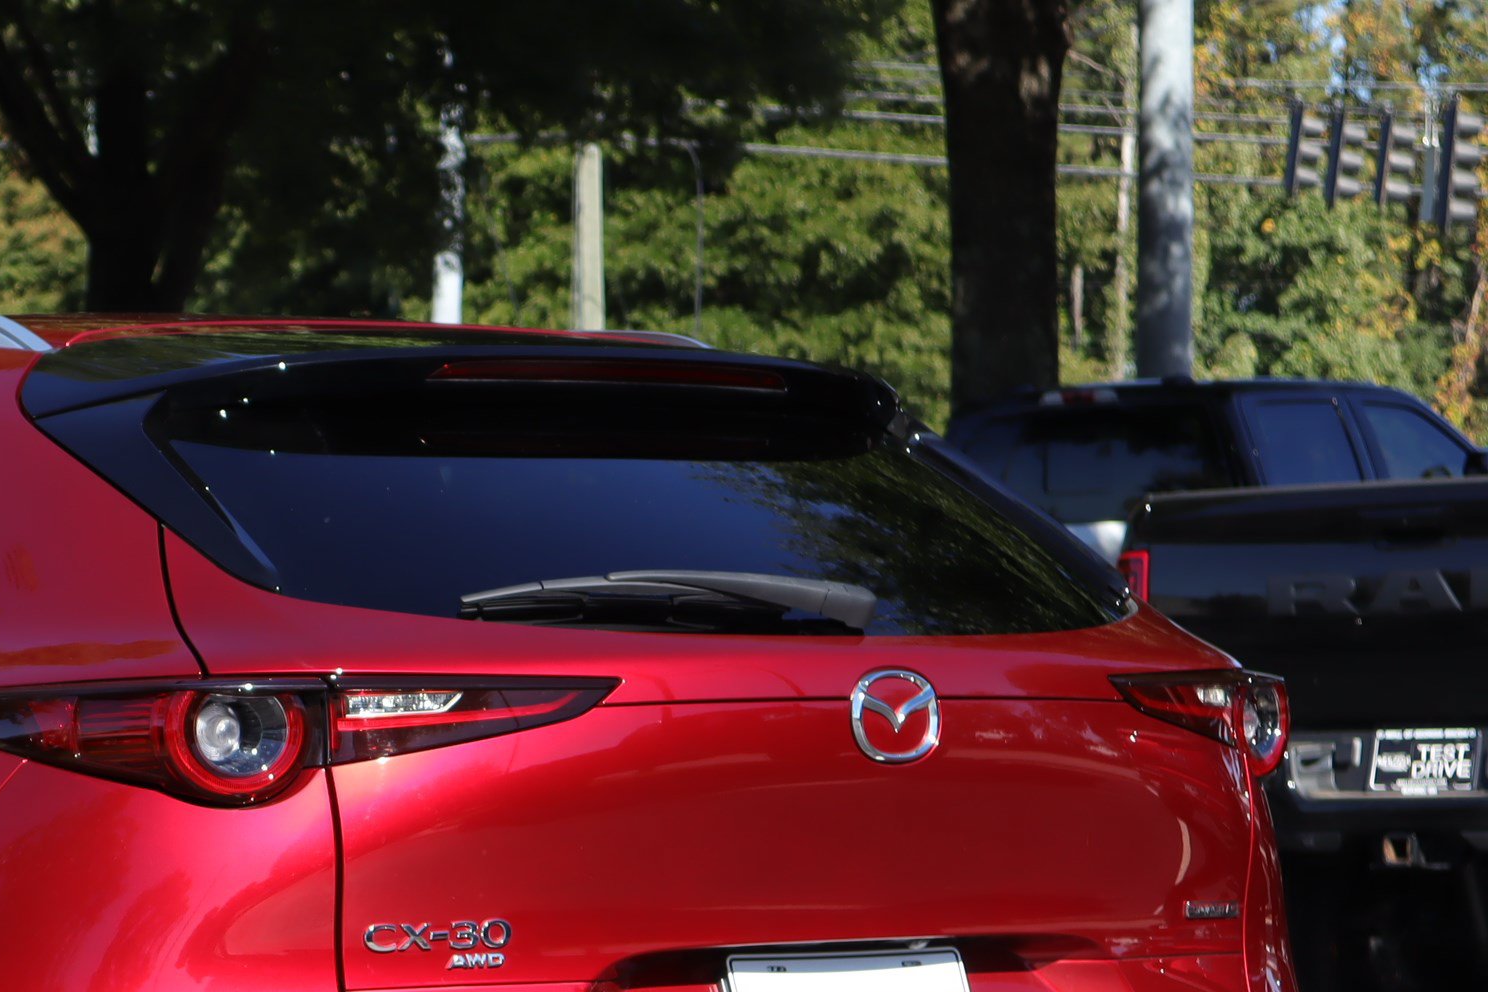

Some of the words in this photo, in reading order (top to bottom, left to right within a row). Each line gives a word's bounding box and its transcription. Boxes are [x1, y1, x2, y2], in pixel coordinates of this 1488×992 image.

[1417, 743, 1471, 761] TEST
[364, 917, 512, 952] CX-30
[445, 952, 506, 970] AWD
